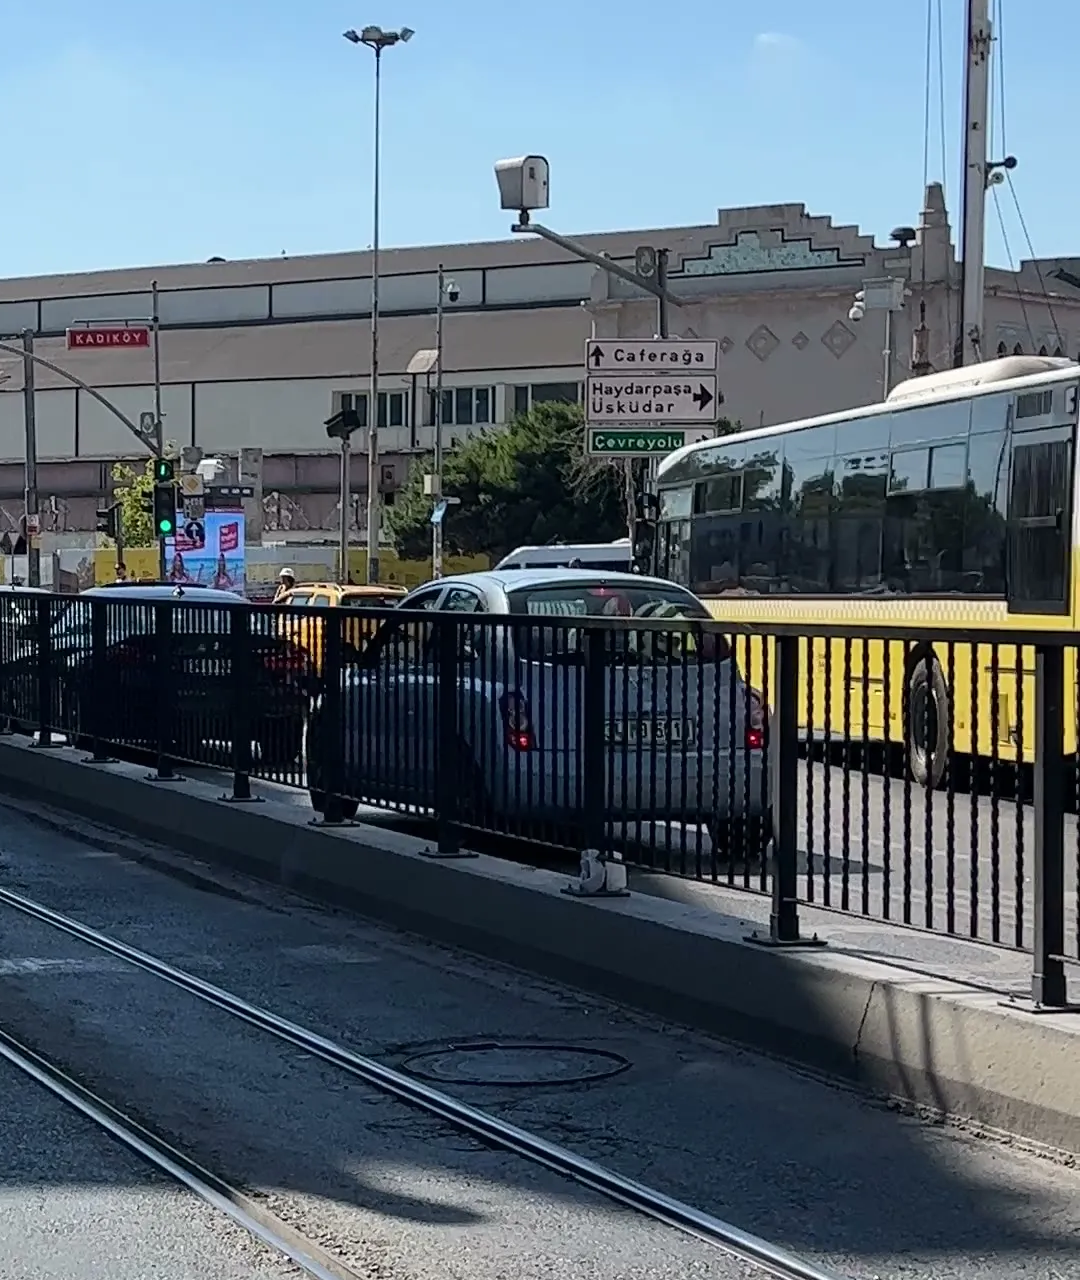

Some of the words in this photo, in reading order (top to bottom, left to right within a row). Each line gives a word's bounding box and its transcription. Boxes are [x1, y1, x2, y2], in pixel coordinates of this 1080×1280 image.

[75, 331, 141, 344] KADIKÖY
[613, 348, 704, 366] Caferağa
[592, 382, 692, 399] Haydarpaşa
[592, 397, 675, 414] Üsküdar
[594, 435, 683, 450] Çevreyolu
